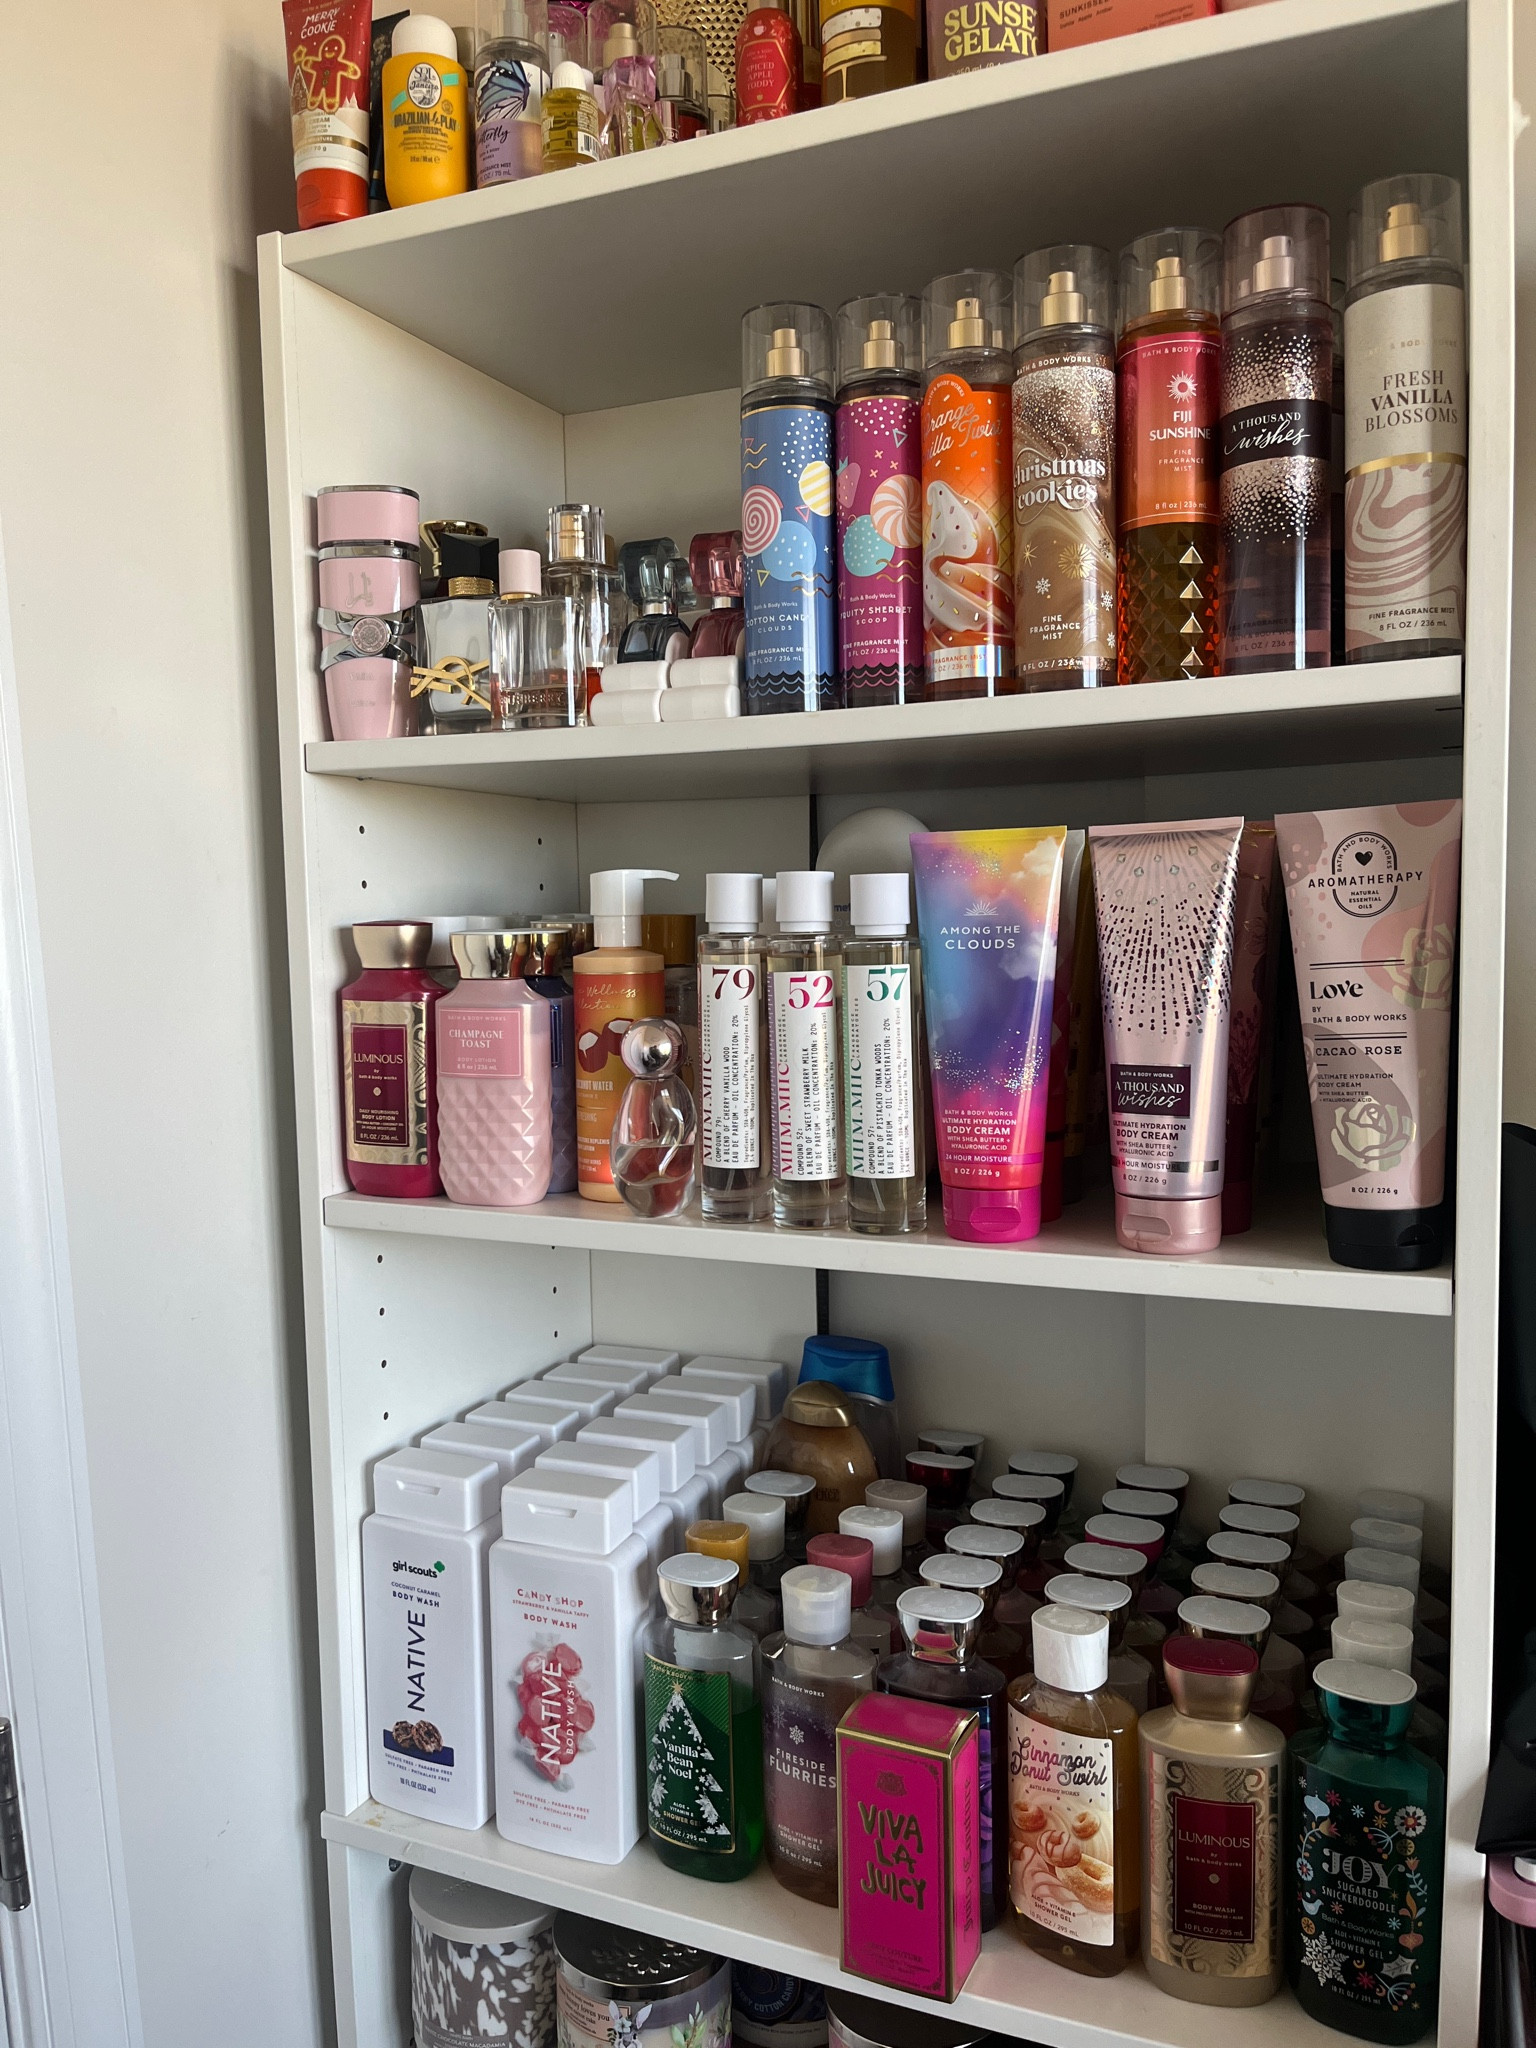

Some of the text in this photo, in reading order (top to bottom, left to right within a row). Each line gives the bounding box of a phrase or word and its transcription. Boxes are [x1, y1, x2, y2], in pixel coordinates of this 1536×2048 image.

[302, 7, 340, 29] MERRY
[944, 1, 1037, 36] SUNSE
[301, 20, 337, 39] COOKIE
[747, 62, 775, 73] SPICED
[748, 71, 773, 81] APPLE
[748, 80, 775, 90] TODDY
[1383, 370, 1443, 390] FRESH
[1371, 389, 1453, 411] VANILLA
[1173, 410, 1192, 423] FIJI
[1231, 412, 1301, 433] A THOUSAND
[1365, 407, 1458, 433] BLOSSOMS
[1149, 427, 1211, 441] SUNSHINE
[1224, 419, 1311, 455] wishes
[1018, 478, 1098, 510] cookies
[747, 615, 775, 627] COTTON
[840, 606, 913, 620] FRUITY SHERBET
[856, 617, 888, 626] SCOOP
[1368, 612, 1386, 620] FINE
[1389, 607, 1438, 617] FRAGRANCE
[758, 625, 793, 634] CLOUDS
[1029, 623, 1080, 634] FRAGRANCE
[1043, 633, 1062, 641] MIST
[1342, 840, 1356, 853] AND
[1359, 837, 1381, 845] BODY
[1381, 844, 1393, 870] WORKS
[1308, 871, 1424, 888] AROMATHERAPY
[940, 925, 1020, 935] AMONG THE
[945, 938, 1015, 949] CLOUDS
[712, 967, 755, 1000] 79
[789, 975, 833, 1010] 52
[867, 967, 908, 1001] 57
[1310, 980, 1363, 999] Love
[449, 1029, 504, 1039] CHAMPAGNE
[461, 1040, 491, 1049] TOAST
[874, 1044, 882, 1064] WOODS
[1315, 1046, 1402, 1056] CACAO ROSE
[354, 1053, 403, 1064] LUMINOUS
[811, 1040, 819, 1096] CONCENTRATION:
[803, 1068, 811, 1108] STRAWBERRY
[1115, 1081, 1184, 1094] A THOUSAND
[1117, 1089, 1181, 1109] wishes
[875, 1092, 883, 1130] PISTACHIO
[723, 1124, 730, 1132] OF
[804, 1112, 812, 1131] SWEET
[942, 1117, 971, 1125] ULTIMATE
[947, 1126, 1010, 1135] BODY CREAM
[1140, 1122, 1187, 1131] HYDRATION
[805, 1136, 812, 1144] OF
[876, 1134, 884, 1142] OF
[885, 1120, 893, 1146] PARFUM
[1117, 1129, 1179, 1141] BODY CREAM
[732, 1140, 739, 1148] DE
[886, 1150, 893, 1158] DE
[974, 1155, 1013, 1163] MOISTURE
[392, 1561, 437, 1578] girl scouts
[391, 1581, 441, 1598] COCONUT CARAMEL
[517, 1588, 584, 1608] CANDY SHOP
[392, 1591, 440, 1608] BODY WASH
[523, 1613, 577, 1630] BODY WASH
[407, 1610, 425, 1712] NATIVE
[541, 1660, 562, 1765] NATIVE
[566, 1680, 575, 1755] BODY WASH
[661, 1738, 699, 1759] Vanilla
[1017, 1736, 1096, 1770] Cinnamon
[666, 1752, 694, 1769] Bean
[776, 1748, 826, 1772] FIRESIDE
[1010, 1750, 1108, 1786] Donut Swirl
[668, 1764, 692, 1780] Noel
[769, 1755, 836, 1788] FLURRIES
[858, 1801, 924, 1854] VIVA
[1178, 1829, 1250, 1849] LUMINOUS
[874, 1838, 917, 1874] LA
[1322, 1848, 1405, 1889] JOY
[860, 1860, 927, 1911] JUICY
[1337, 1880, 1378, 1899] SUGARED
[1192, 1903, 1236, 1913] BODY WASH
[1322, 1885, 1395, 1913] SNICKERDOODLE
[1034, 1901, 1072, 1923] SHOWER GEL
[1330, 1937, 1383, 1960] SHOWER GEL
[754, 1976, 795, 2012] COTTON CANDY
[581, 2004, 610, 2022] loves you
